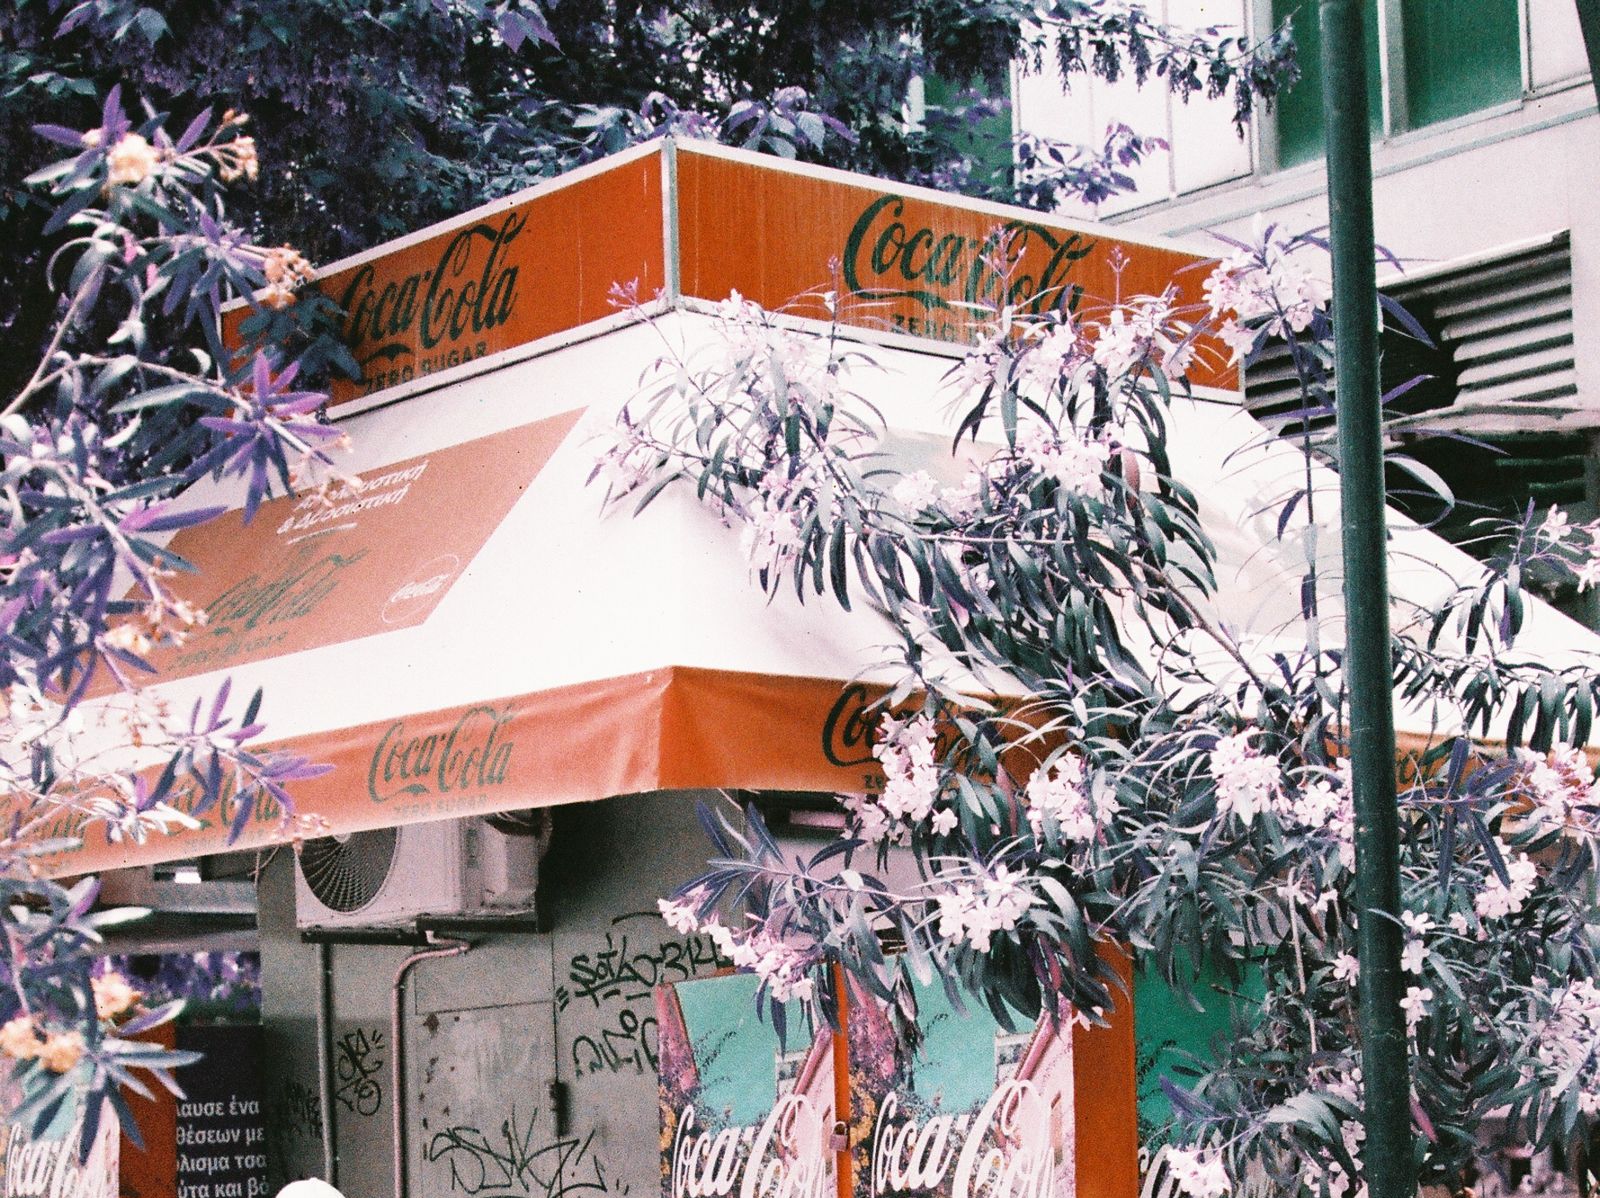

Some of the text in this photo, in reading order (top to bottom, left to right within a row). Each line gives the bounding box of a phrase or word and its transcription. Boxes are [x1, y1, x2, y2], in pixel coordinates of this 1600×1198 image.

[340, 211, 529, 362] Coca-Cola
[368, 703, 515, 803] Coca-Cola
[229, 1095, 260, 1116] ένα
[246, 1127, 265, 1147] με
[176, 1154, 230, 1175] λισμα
[215, 1182, 242, 1198] και
